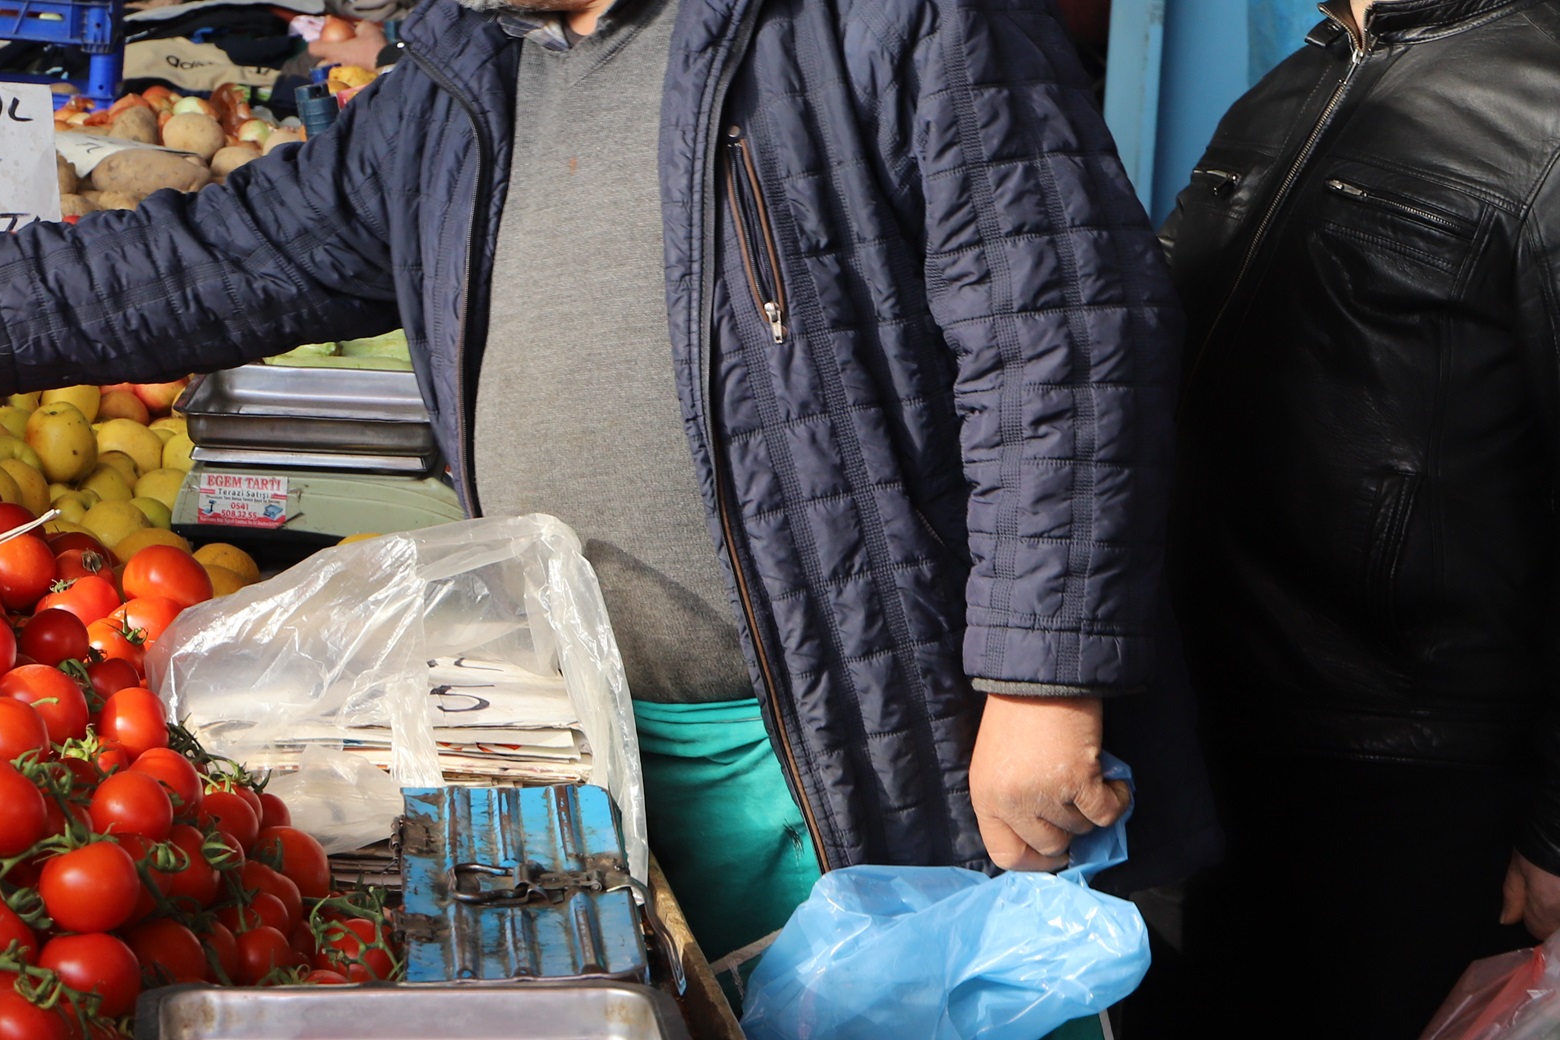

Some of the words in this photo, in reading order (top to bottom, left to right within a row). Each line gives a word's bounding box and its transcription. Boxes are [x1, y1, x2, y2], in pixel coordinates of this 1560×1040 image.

[207, 474, 242, 488] EGEM
[218, 488, 244, 497] Terazi
[230, 502, 249, 511] 0541
